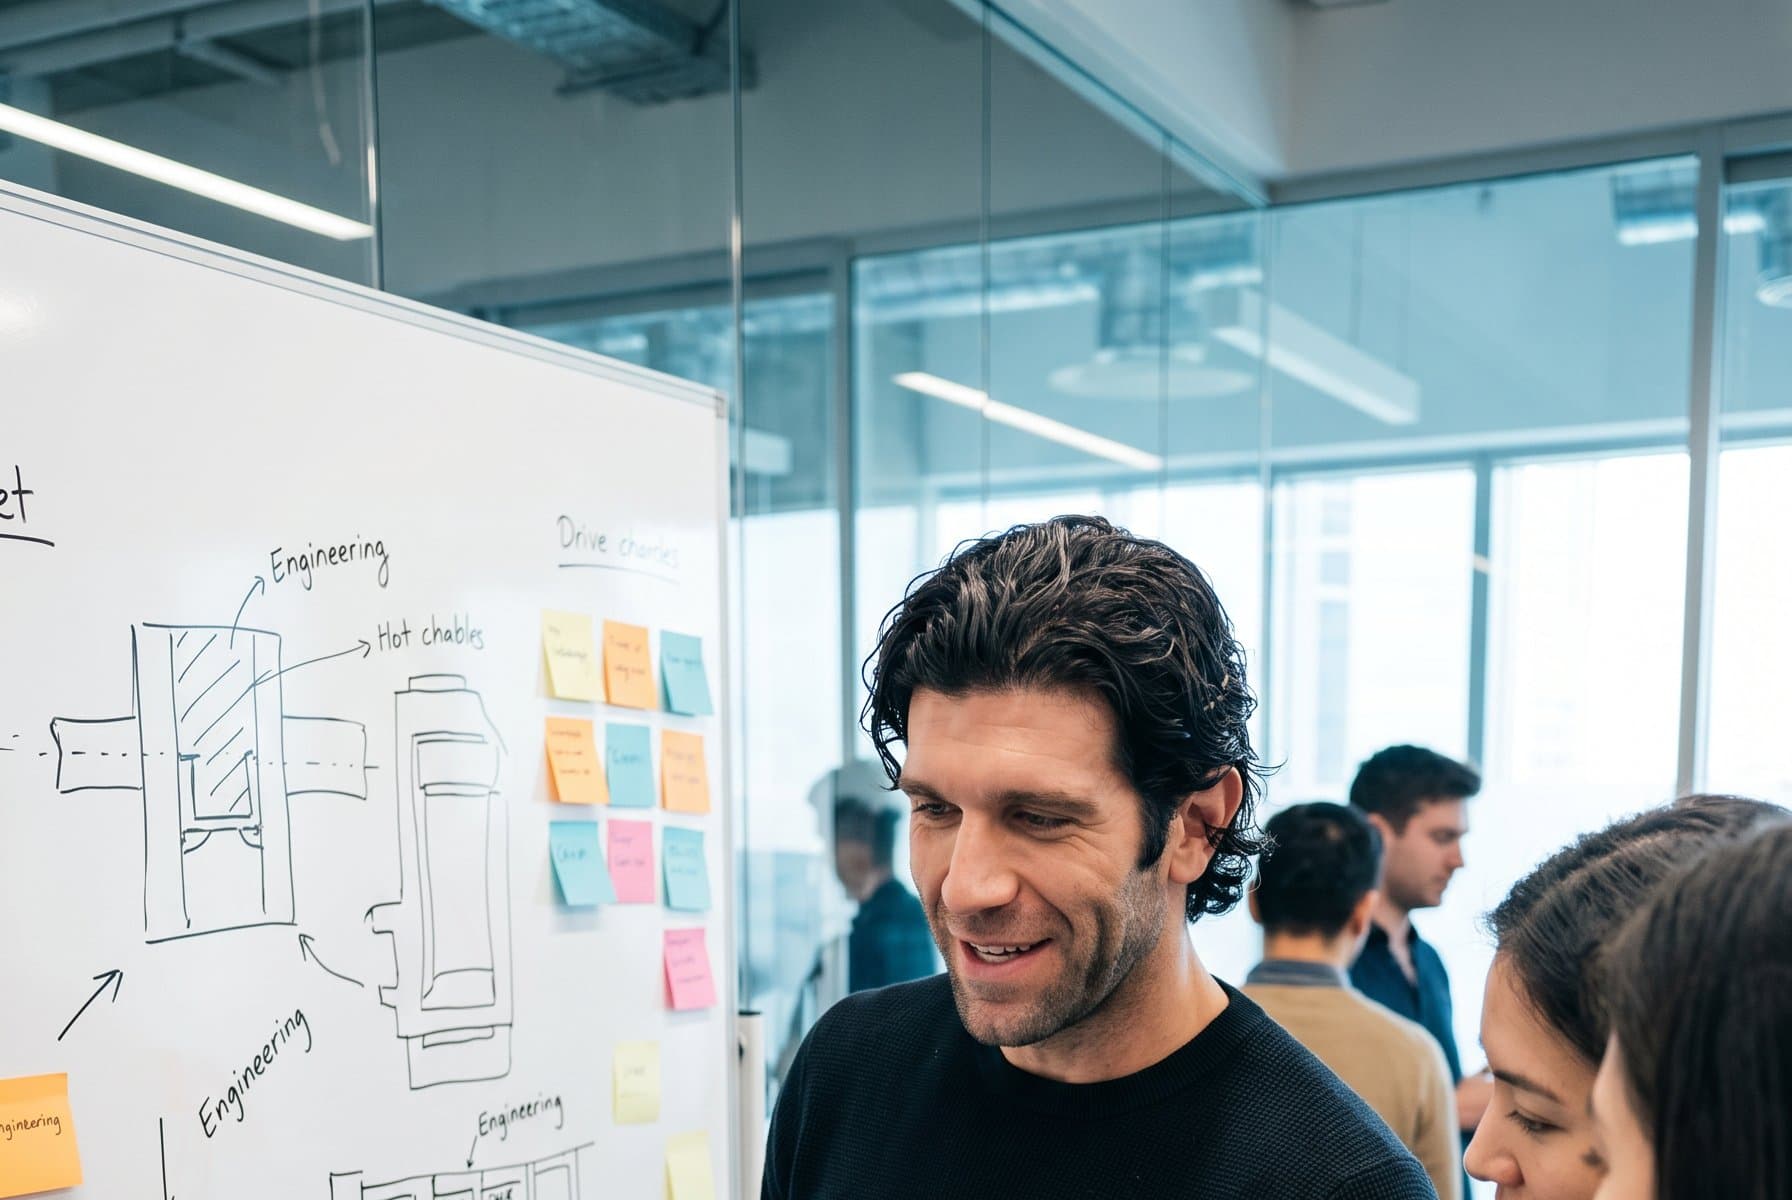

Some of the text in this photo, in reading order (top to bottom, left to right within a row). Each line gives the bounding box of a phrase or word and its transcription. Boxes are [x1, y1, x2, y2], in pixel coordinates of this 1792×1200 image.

[556, 513, 608, 553] Drive
[270, 533, 389, 592] Engineering
[377, 617, 412, 652] Hot
[198, 1008, 312, 1139] Engineering
[478, 1091, 565, 1142] Engineering
